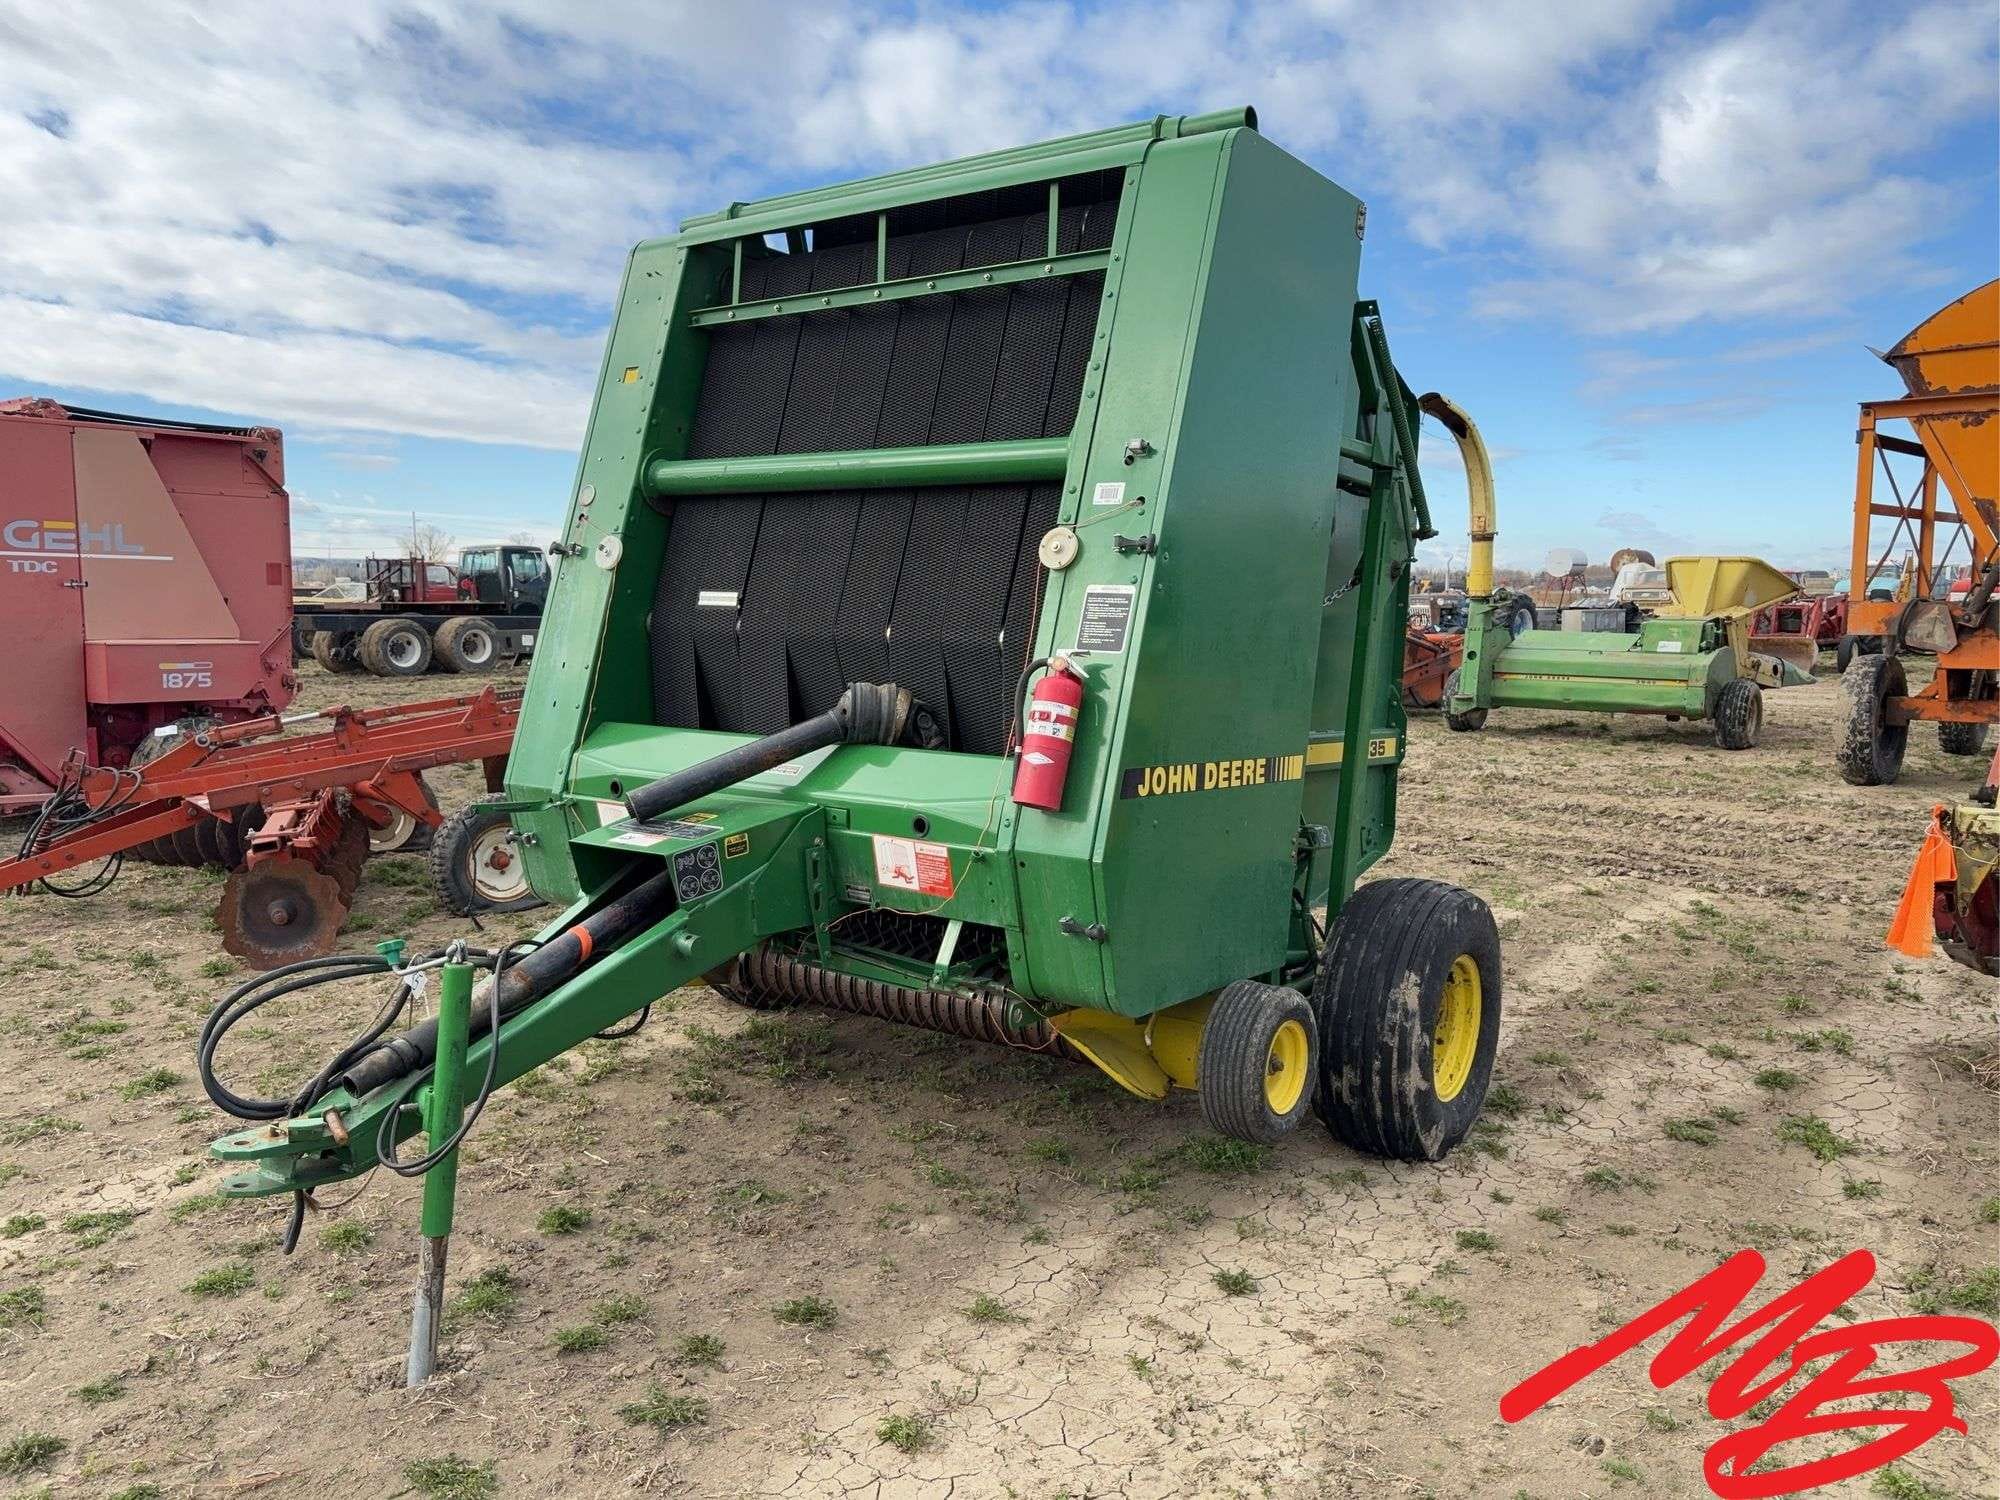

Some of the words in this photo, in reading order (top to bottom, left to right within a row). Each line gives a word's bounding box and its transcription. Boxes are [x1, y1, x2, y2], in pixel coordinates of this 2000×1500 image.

[3, 519, 145, 553] GEHL
[6, 559, 58, 573] TDC
[161, 672, 212, 689] 1875
[1369, 740, 1386, 756] 35
[1137, 763, 1197, 797] JOHN
[1203, 758, 1266, 790] DEERE
